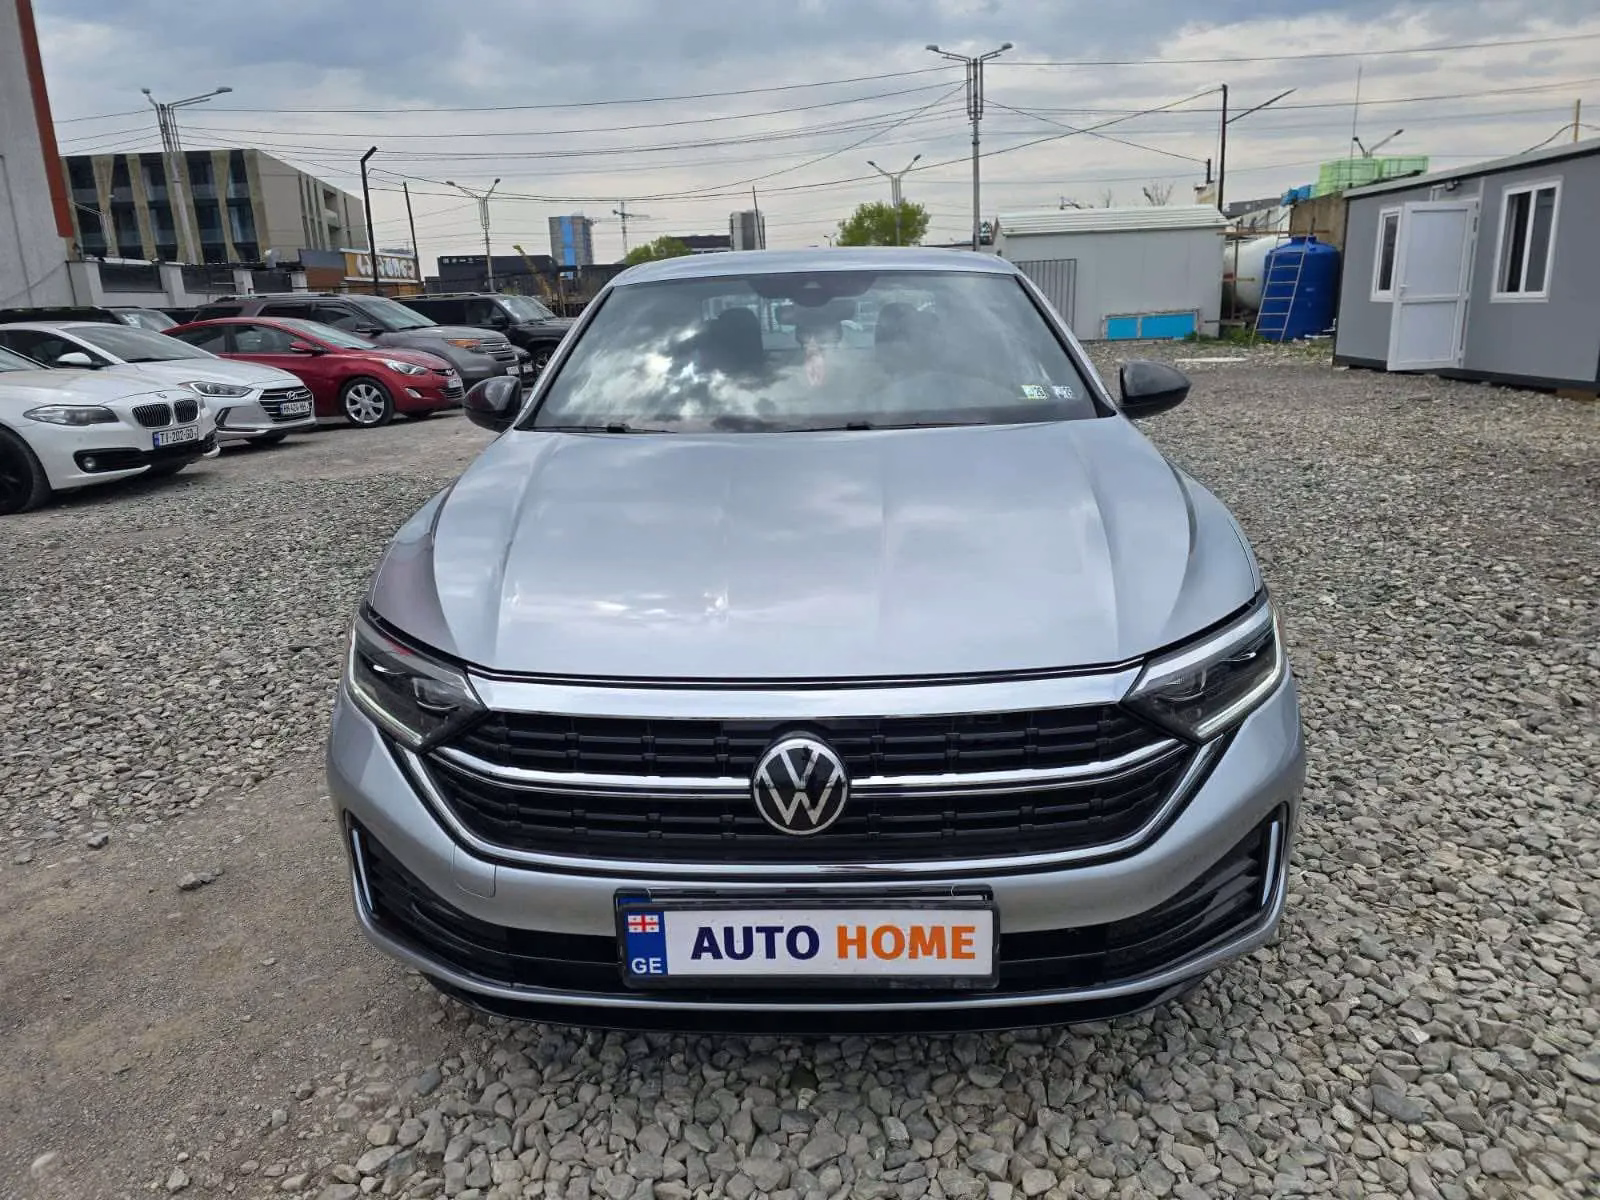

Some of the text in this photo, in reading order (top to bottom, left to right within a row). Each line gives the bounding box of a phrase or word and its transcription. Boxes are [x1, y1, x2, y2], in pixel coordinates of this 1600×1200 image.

[690, 925, 977, 961] AUTO HOME
[631, 957, 663, 975] GE
